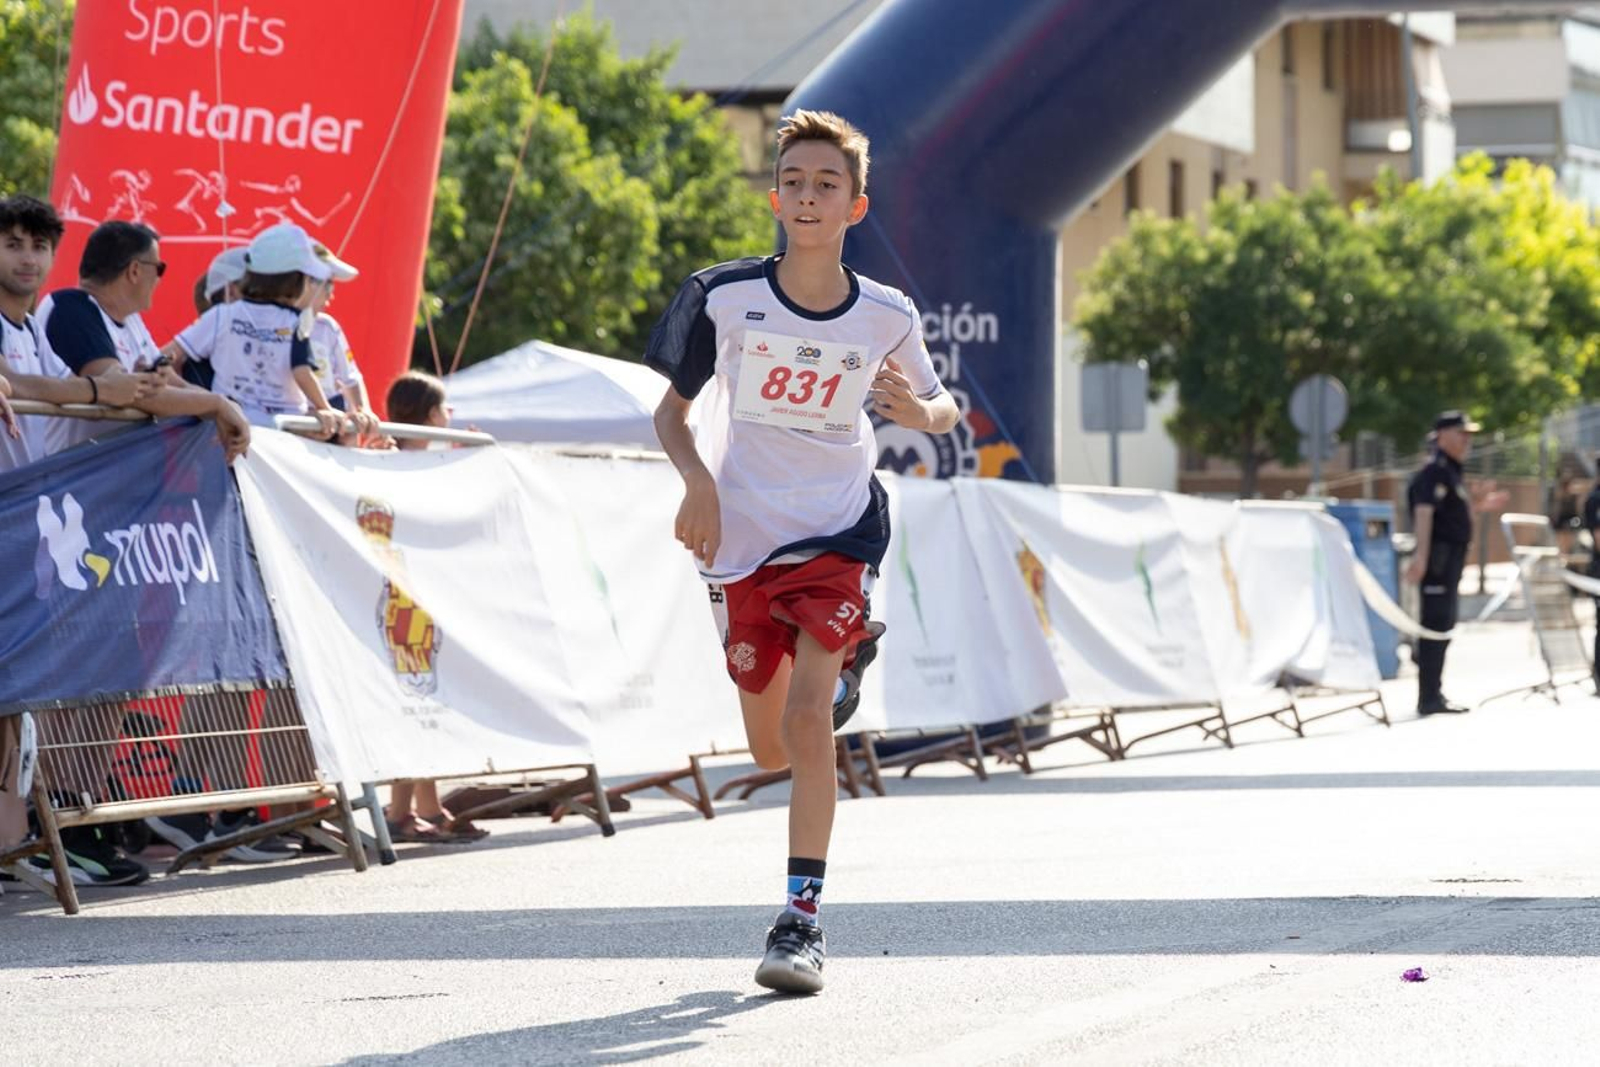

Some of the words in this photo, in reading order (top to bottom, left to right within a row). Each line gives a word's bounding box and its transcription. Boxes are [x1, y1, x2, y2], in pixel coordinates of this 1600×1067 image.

[124, 0, 286, 56] Sports
[101, 80, 363, 154] Santander
[922, 303, 998, 342] ción
[760, 366, 842, 408] 831
[931, 344, 960, 381] ol
[103, 498, 220, 605] mupol
